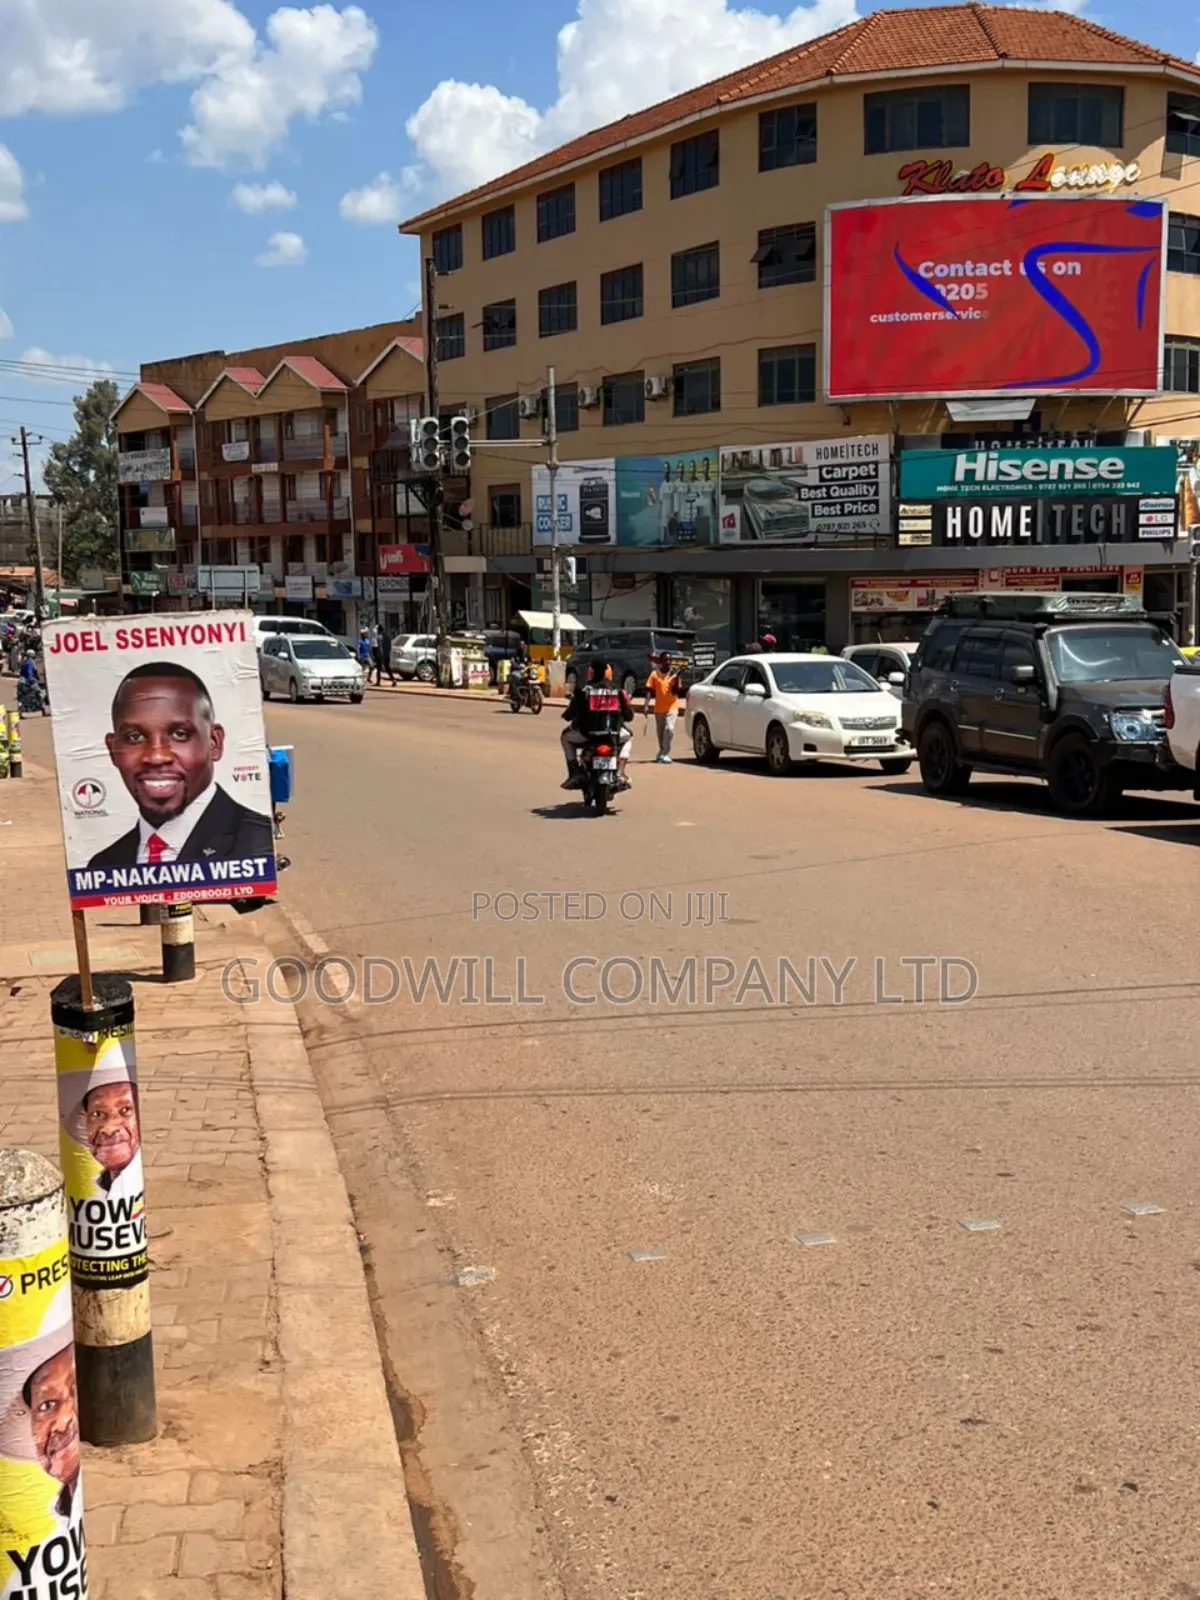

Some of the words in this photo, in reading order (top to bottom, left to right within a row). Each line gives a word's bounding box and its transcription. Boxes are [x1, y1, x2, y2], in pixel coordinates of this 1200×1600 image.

[1015, 153, 1141, 194] Lounge
[918, 259, 1012, 278] Contact
[1053, 260, 1081, 276] on
[815, 445, 845, 460] HOME
[850, 443, 879, 458] TECH
[821, 463, 876, 480] Carpet
[955, 452, 1124, 481] Hisense
[800, 487, 827, 499] Best
[829, 484, 876, 498] Quality
[814, 503, 842, 516] Best
[844, 501, 877, 514] Price
[946, 505, 1032, 539] HOME
[1051, 503, 1127, 537] TECH
[50, 631, 108, 654] JOEL
[116, 622, 246, 650] SSENYONYI
[75, 865, 205, 890] MP-NAKAWA
[211, 858, 267, 880] WEST
[103, 895, 132, 905] YOUR
[134, 892, 165, 904] VOICE
